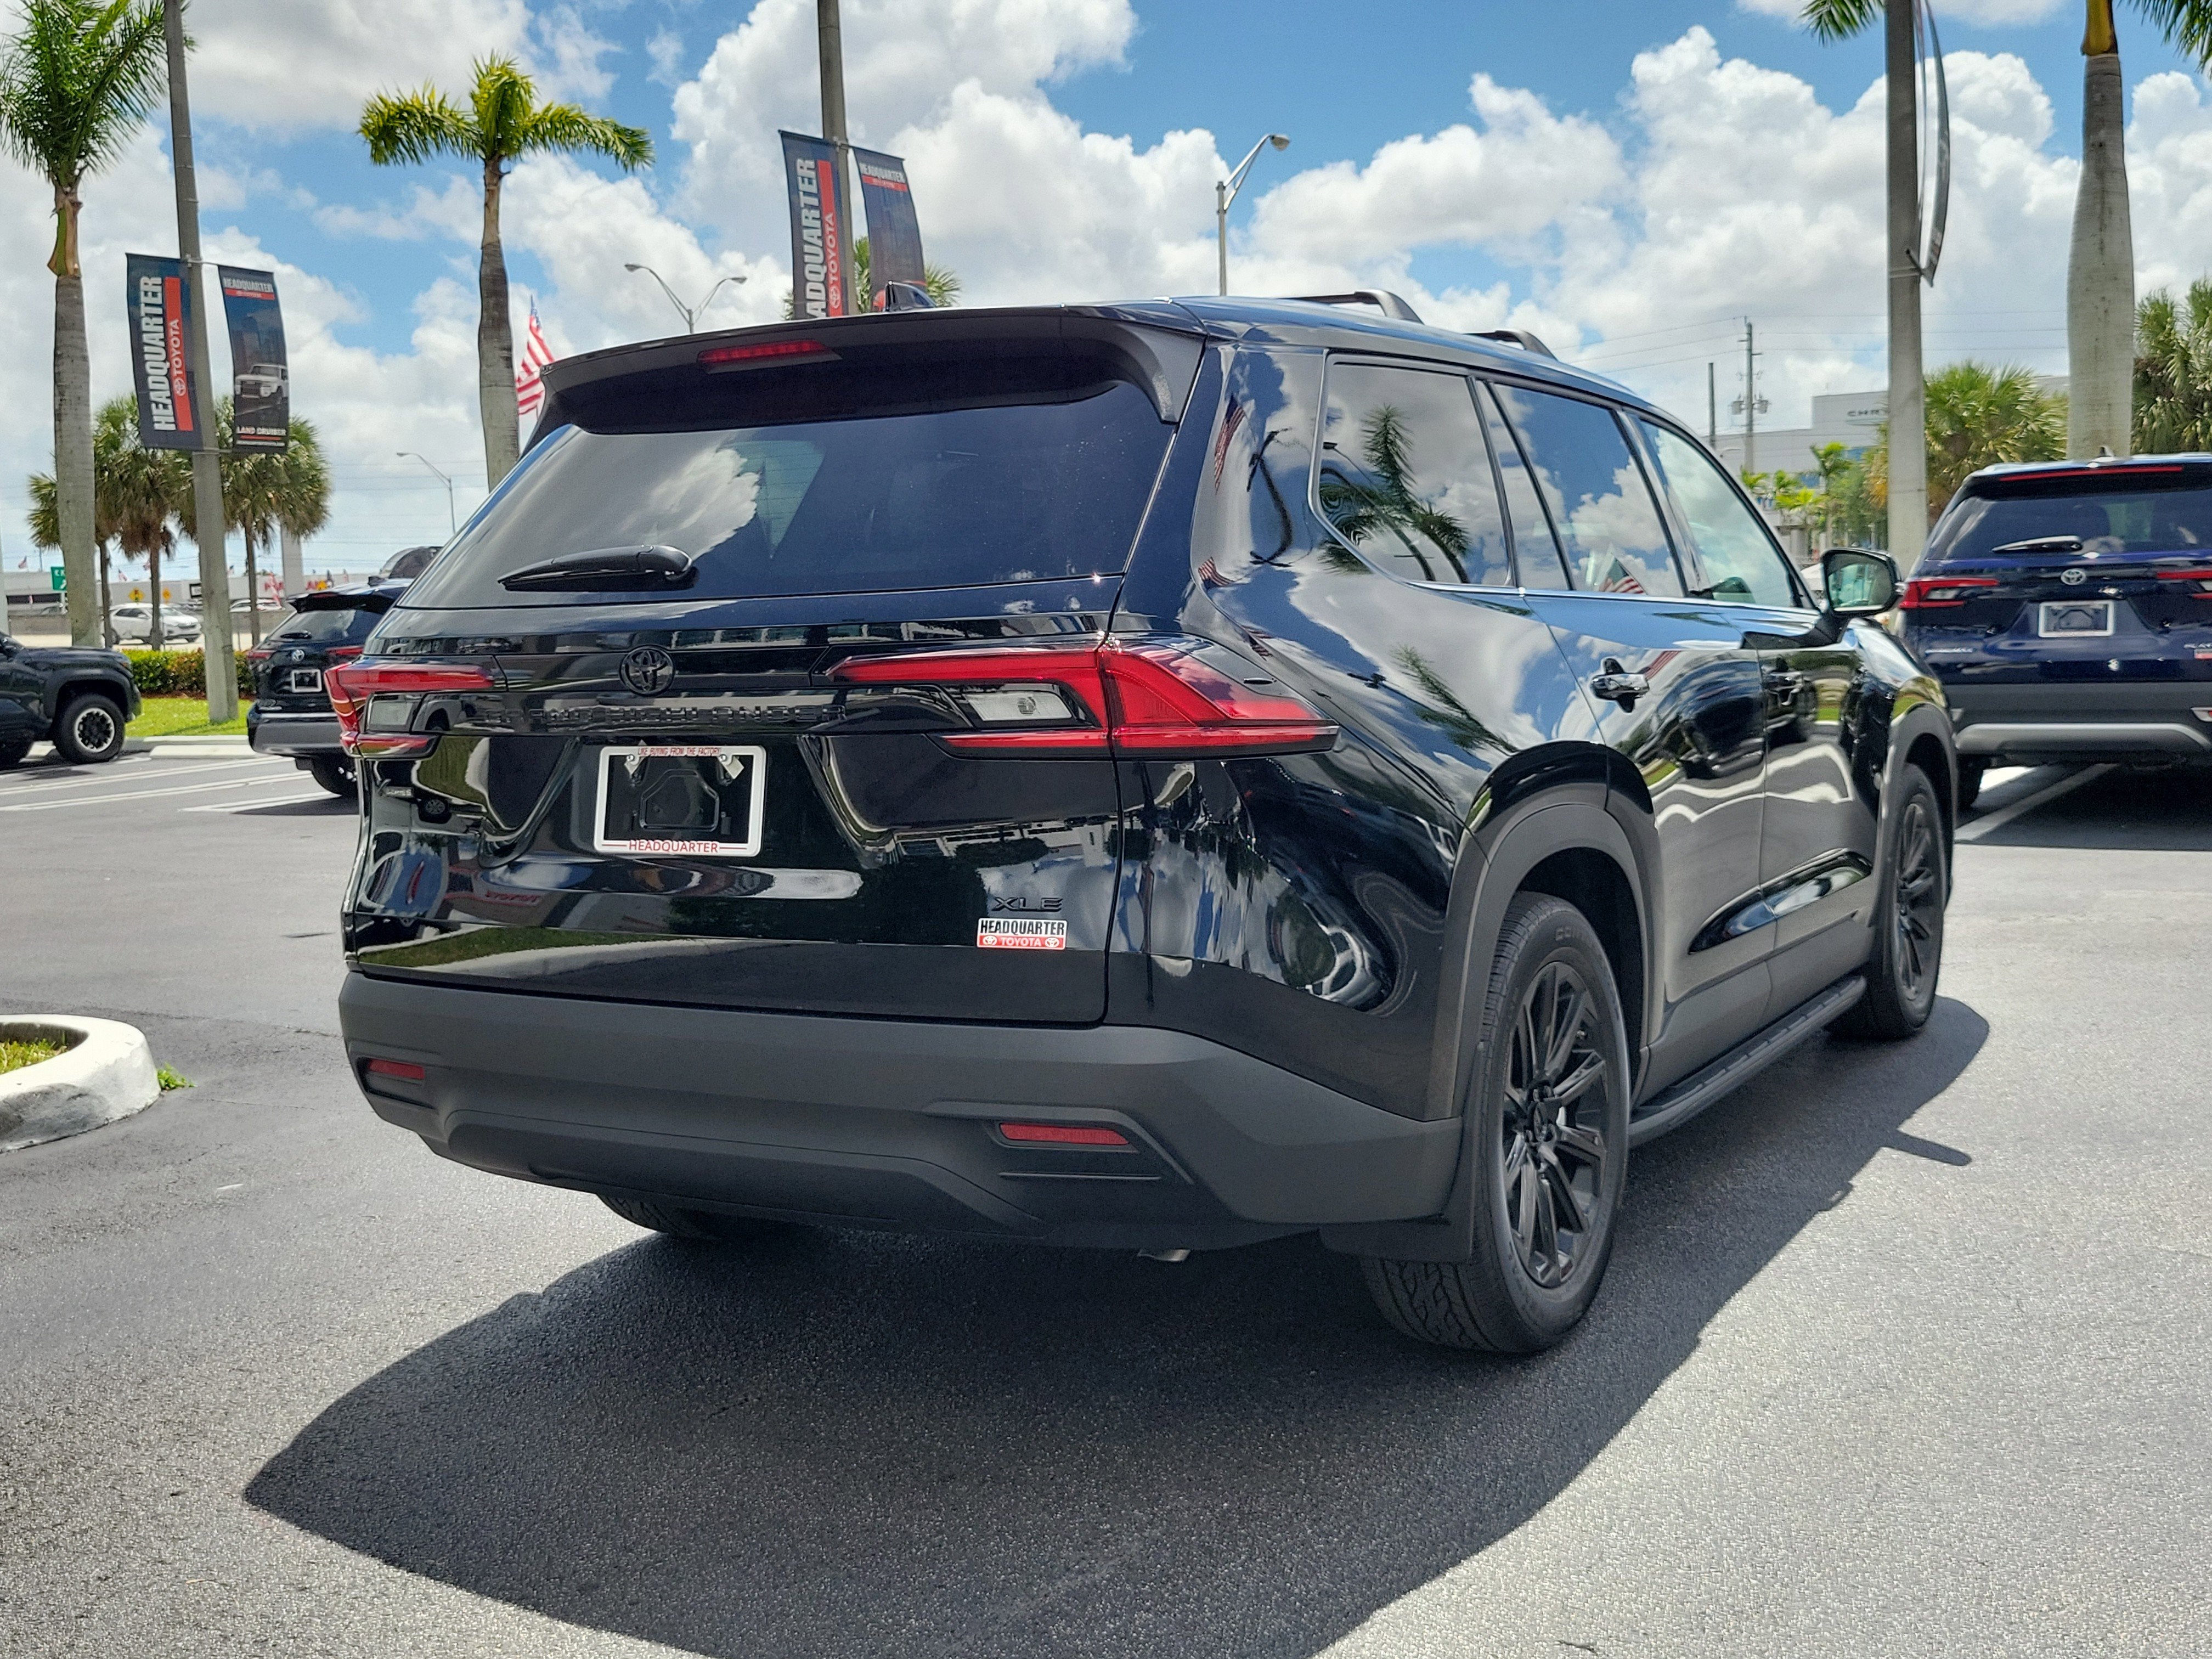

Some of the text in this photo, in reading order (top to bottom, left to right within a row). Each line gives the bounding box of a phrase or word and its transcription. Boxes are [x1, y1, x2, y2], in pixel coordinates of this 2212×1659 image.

[797, 158, 827, 318] ADQUARTER
[825, 213, 838, 285] TOYOTA
[140, 276, 177, 431] HEADQUARTER
[169, 319, 187, 375] TOYOTA
[629, 840, 719, 853] HEADQUARTER
[991, 896, 1063, 912] XLE
[980, 919, 1065, 935] HEADQUARTER
[1001, 937, 1042, 947] TOYOTA
